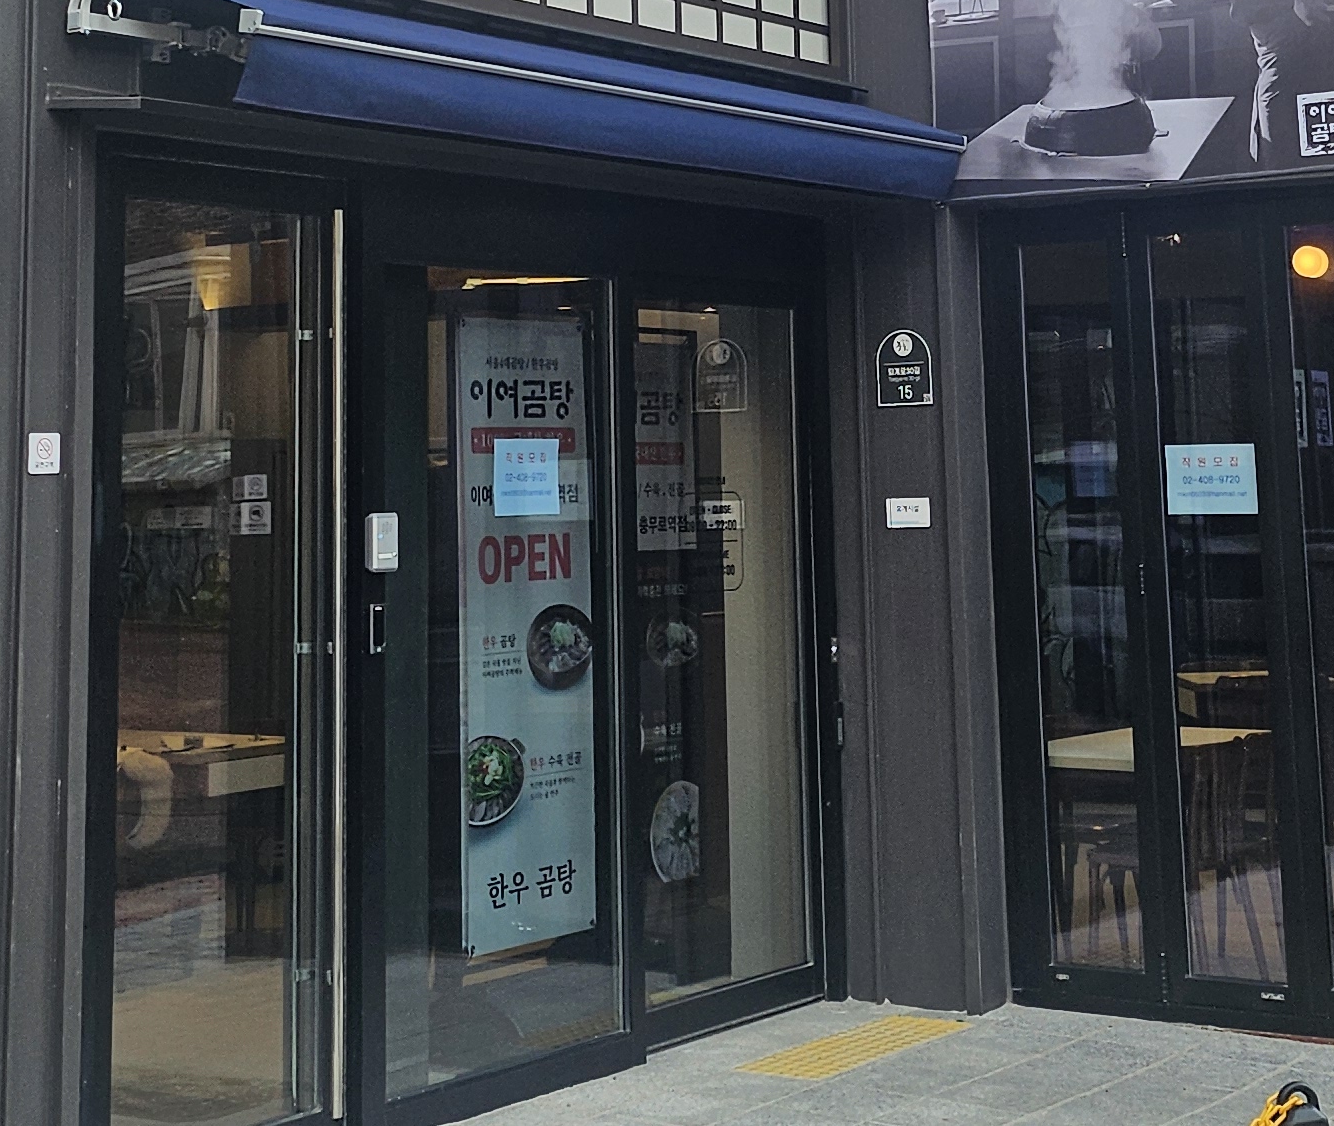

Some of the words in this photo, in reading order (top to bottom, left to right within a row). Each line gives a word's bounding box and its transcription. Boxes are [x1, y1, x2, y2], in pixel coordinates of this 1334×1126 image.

[470, 378, 574, 420] 이여곰탕
[898, 385, 913, 400] 15
[1182, 475, 1241, 485] 02-408-9720
[478, 532, 572, 585] OPEN
[486, 872, 529, 910] 한우
[536, 859, 577, 899] 곰탕
